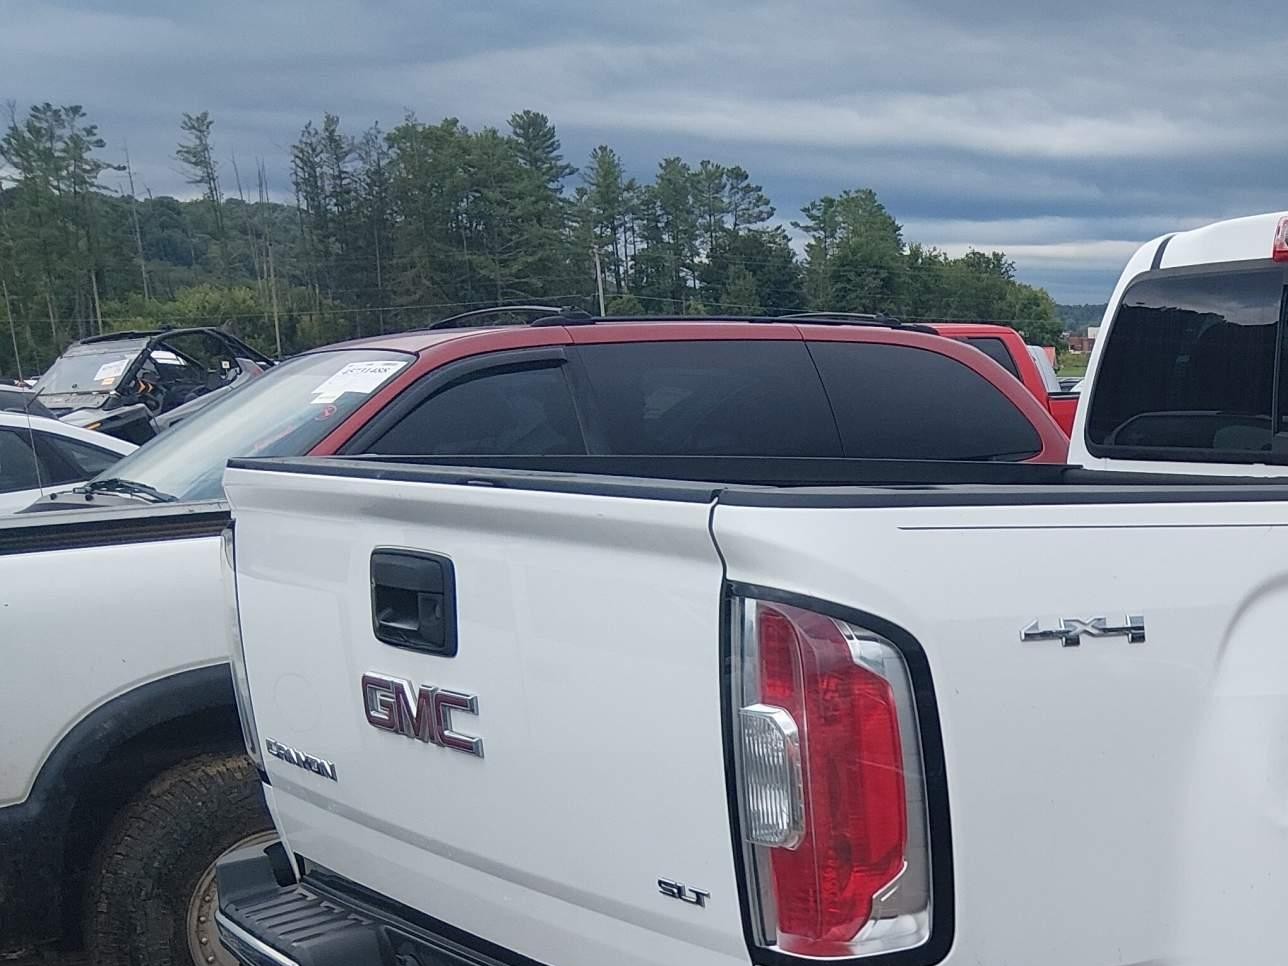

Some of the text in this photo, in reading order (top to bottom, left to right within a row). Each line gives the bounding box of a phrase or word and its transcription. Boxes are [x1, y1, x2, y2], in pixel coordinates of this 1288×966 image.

[361, 671, 484, 758] GMC
[265, 737, 338, 781] CANYON
[657, 877, 711, 908] SLT
